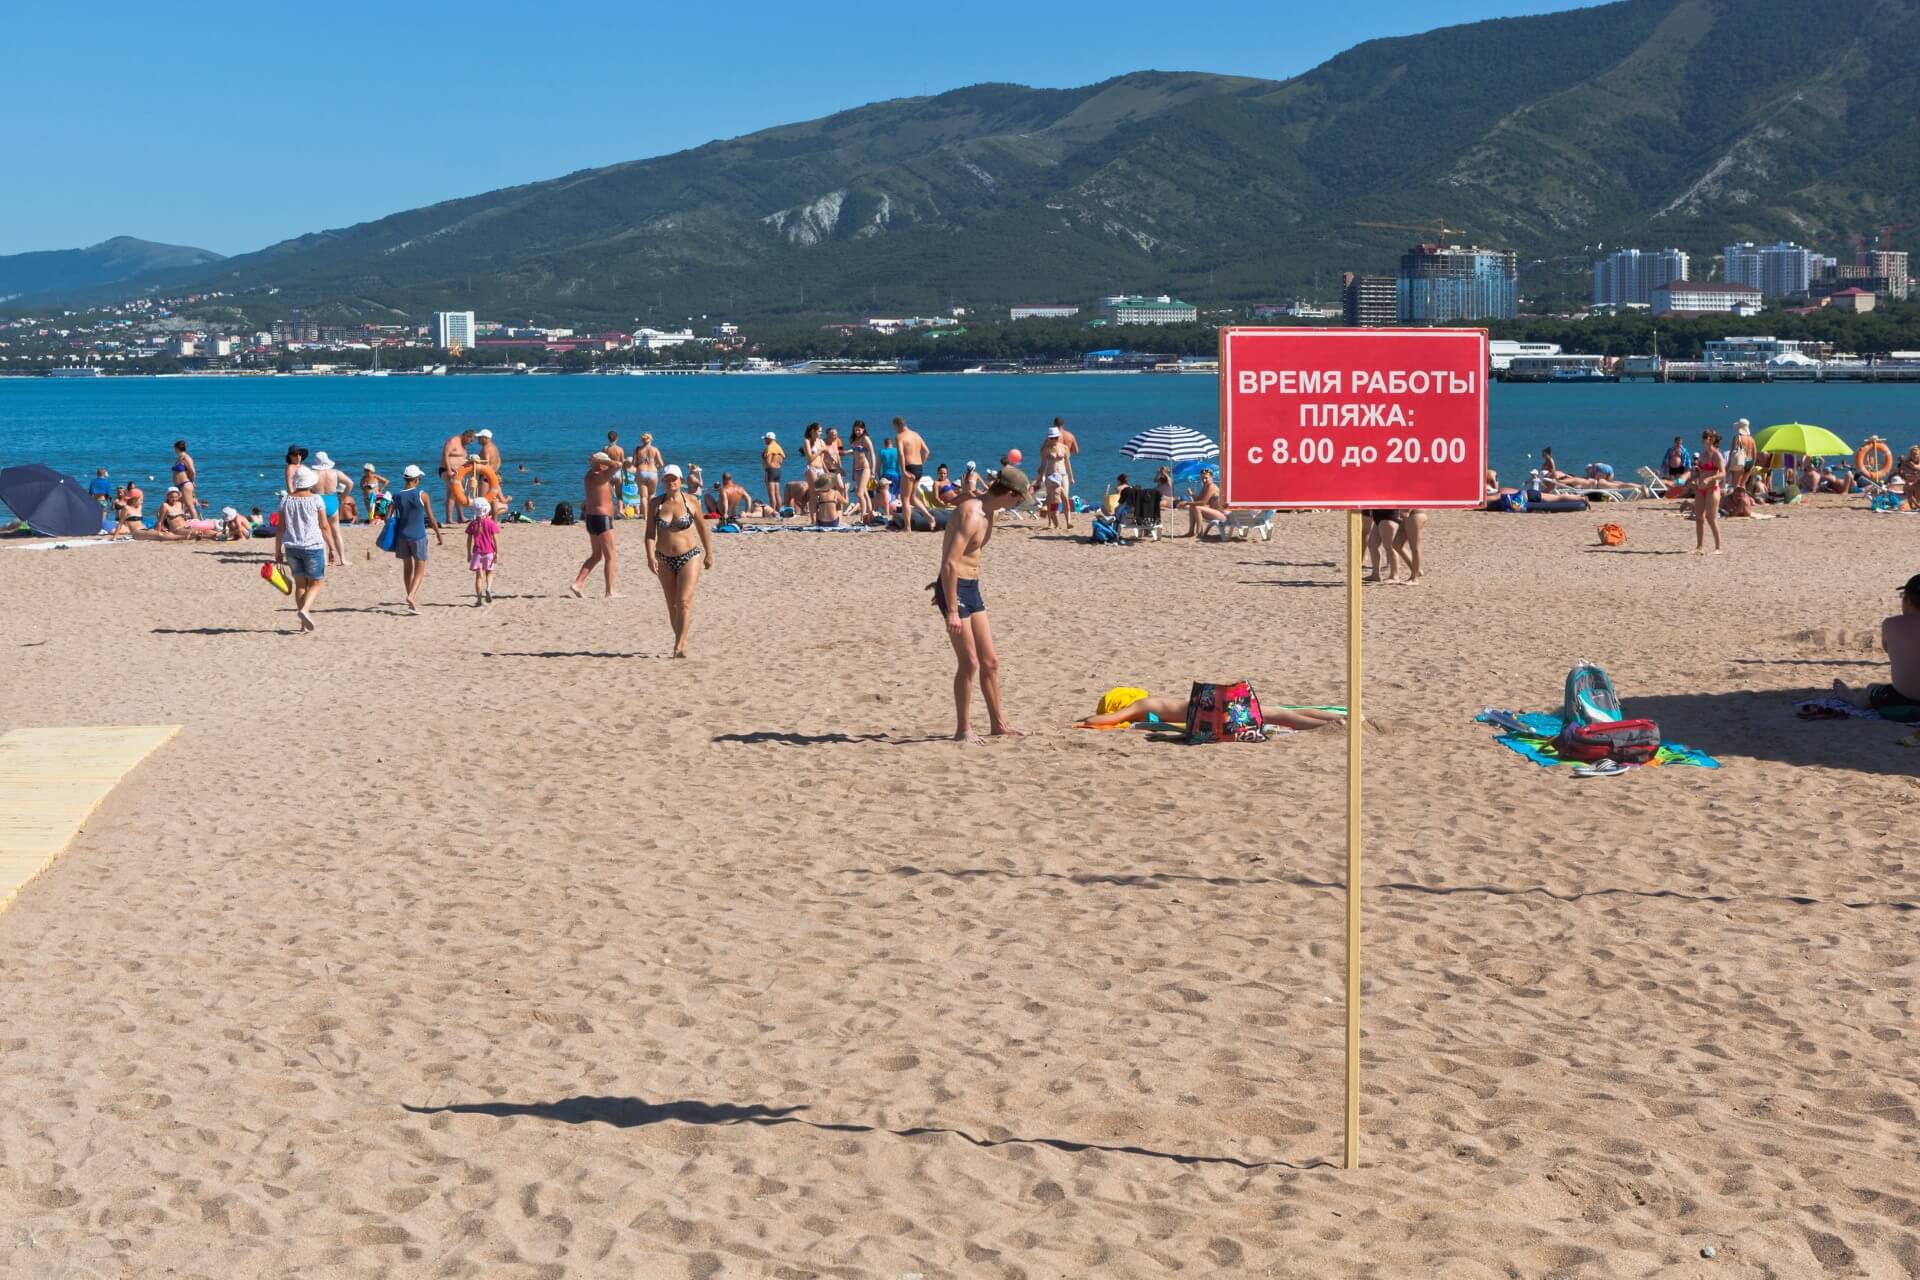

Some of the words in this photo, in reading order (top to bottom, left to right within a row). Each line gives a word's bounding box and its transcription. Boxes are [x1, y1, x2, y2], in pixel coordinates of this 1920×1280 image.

[1238, 370, 1342, 394] ВРЕМЯ
[1351, 370, 1475, 394] РАБОТЫ
[1299, 403, 1414, 427] ПЛЯЖА:
[1247, 446, 1263, 464] с
[1271, 437, 1334, 464] 8.00
[1341, 445, 1378, 468] до
[1386, 437, 1466, 464] 20.00
